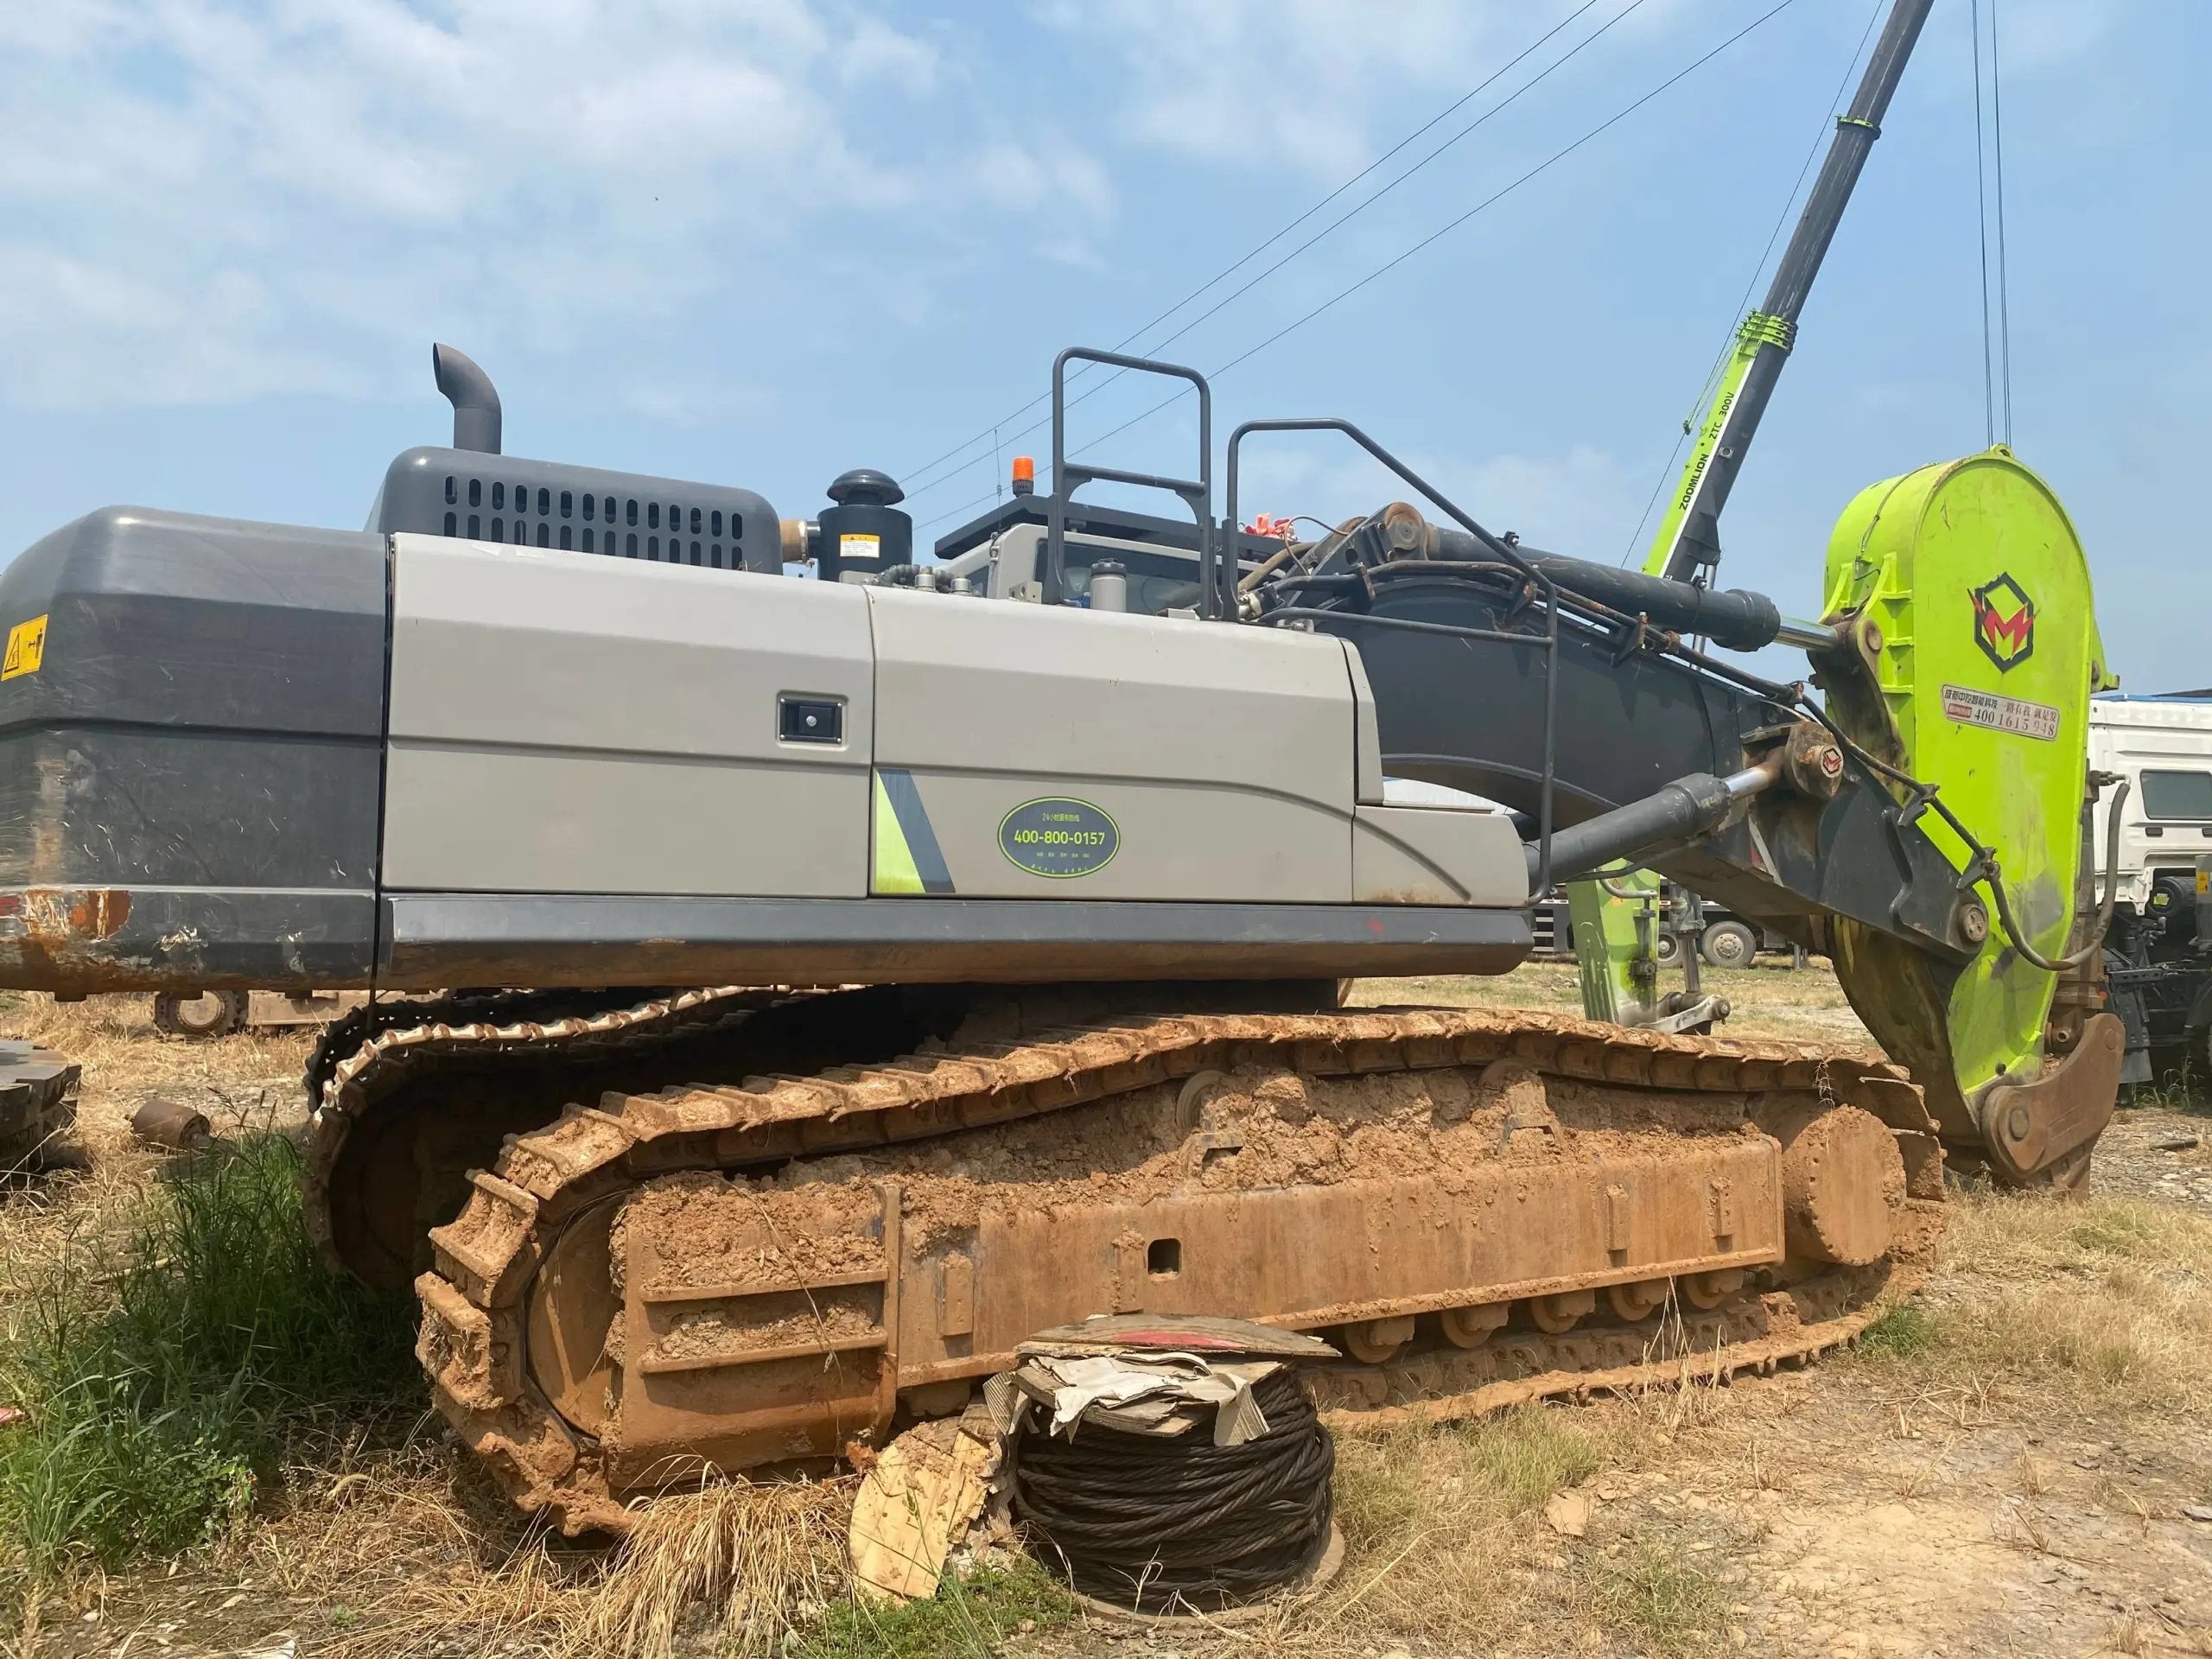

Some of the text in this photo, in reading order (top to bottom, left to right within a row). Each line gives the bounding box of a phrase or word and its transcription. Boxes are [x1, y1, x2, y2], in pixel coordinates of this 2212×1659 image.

[1679, 392, 1734, 511] ZOOMLION ZTC 300V
[1974, 709, 1995, 724] 400
[1998, 713, 2030, 731] 1615
[1014, 830, 1105, 845] 400-800-0157
